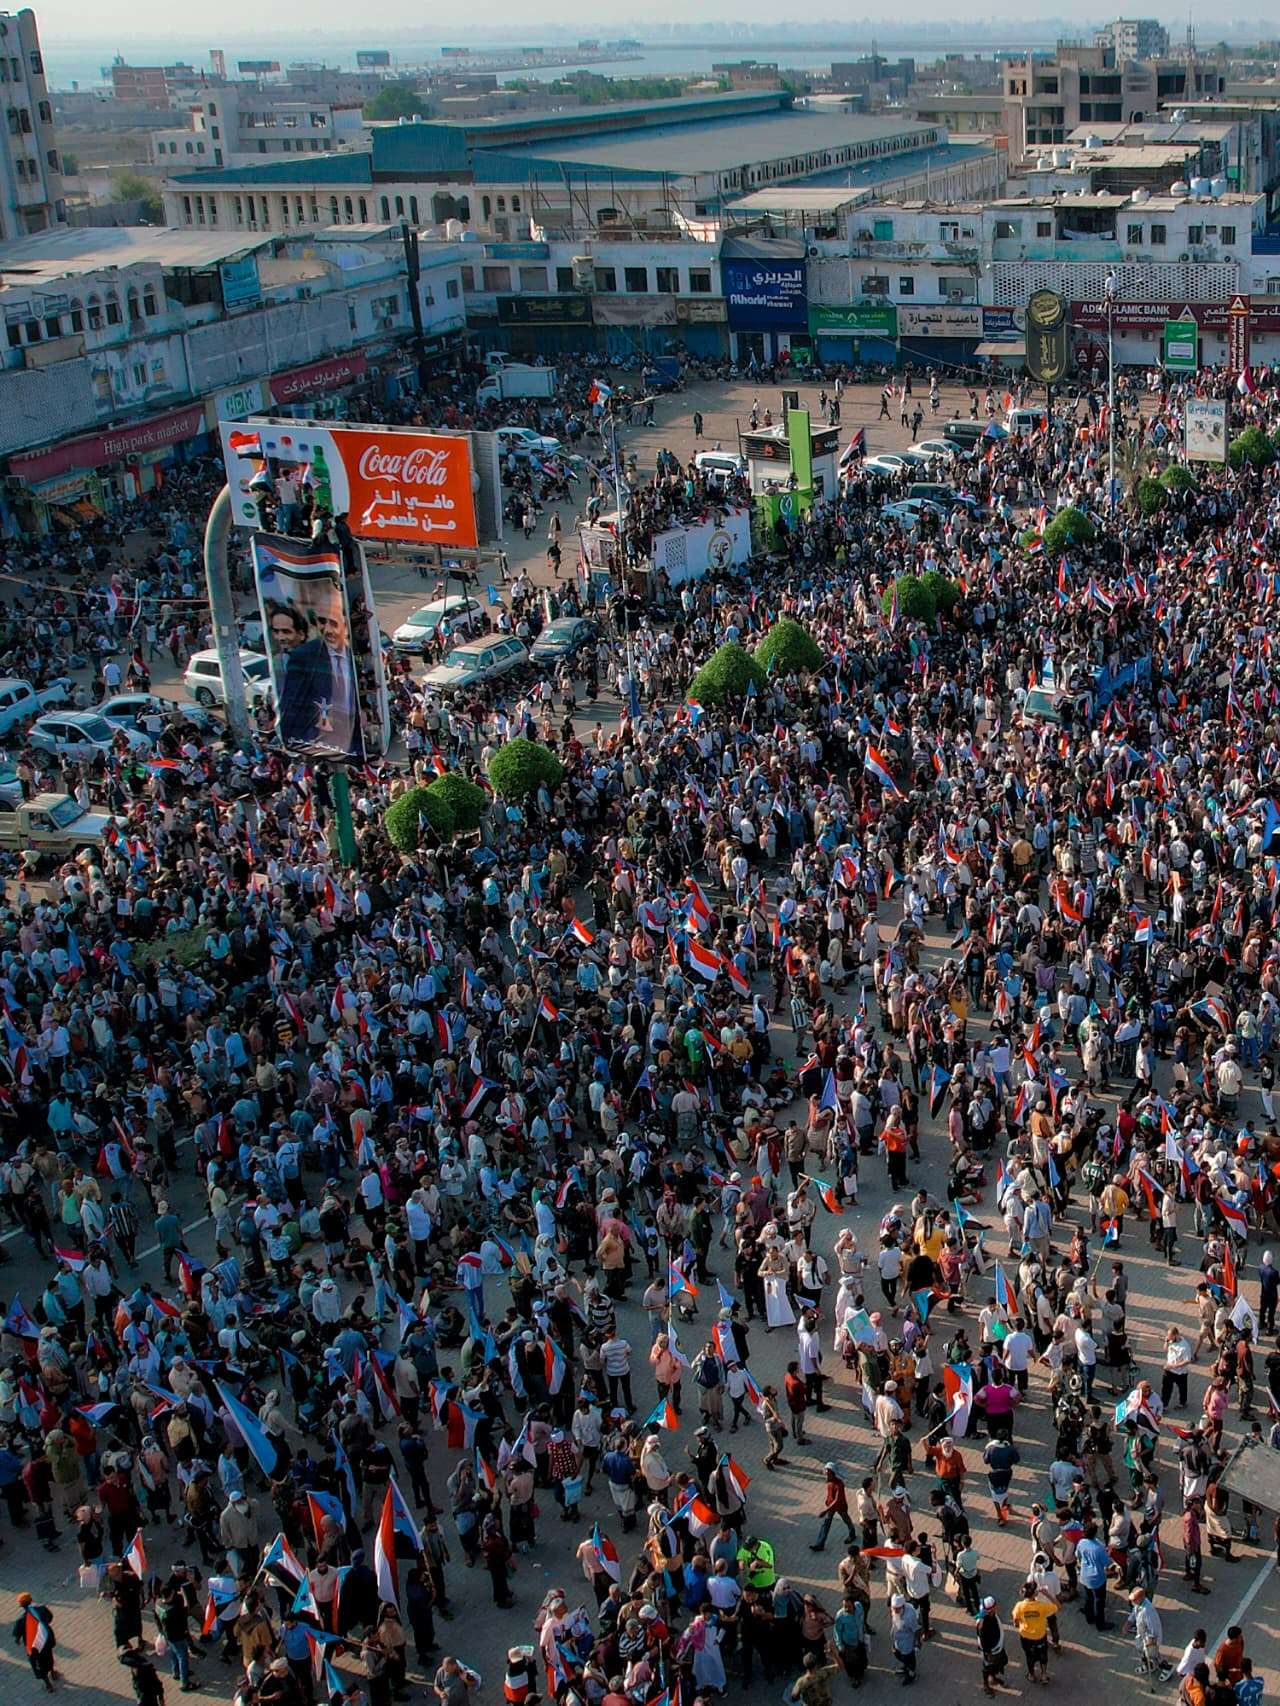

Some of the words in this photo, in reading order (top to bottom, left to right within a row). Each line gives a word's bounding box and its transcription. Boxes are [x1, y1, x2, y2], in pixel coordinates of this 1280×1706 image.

[752, 270, 802, 285] الحريري
[1109, 304, 1144, 315] SLAMIC
[1144, 305, 1170, 315] BANK
[103, 436, 129, 456] High
[130, 430, 155, 451] park
[156, 420, 190, 440] market
[422, 513, 457, 533] من
